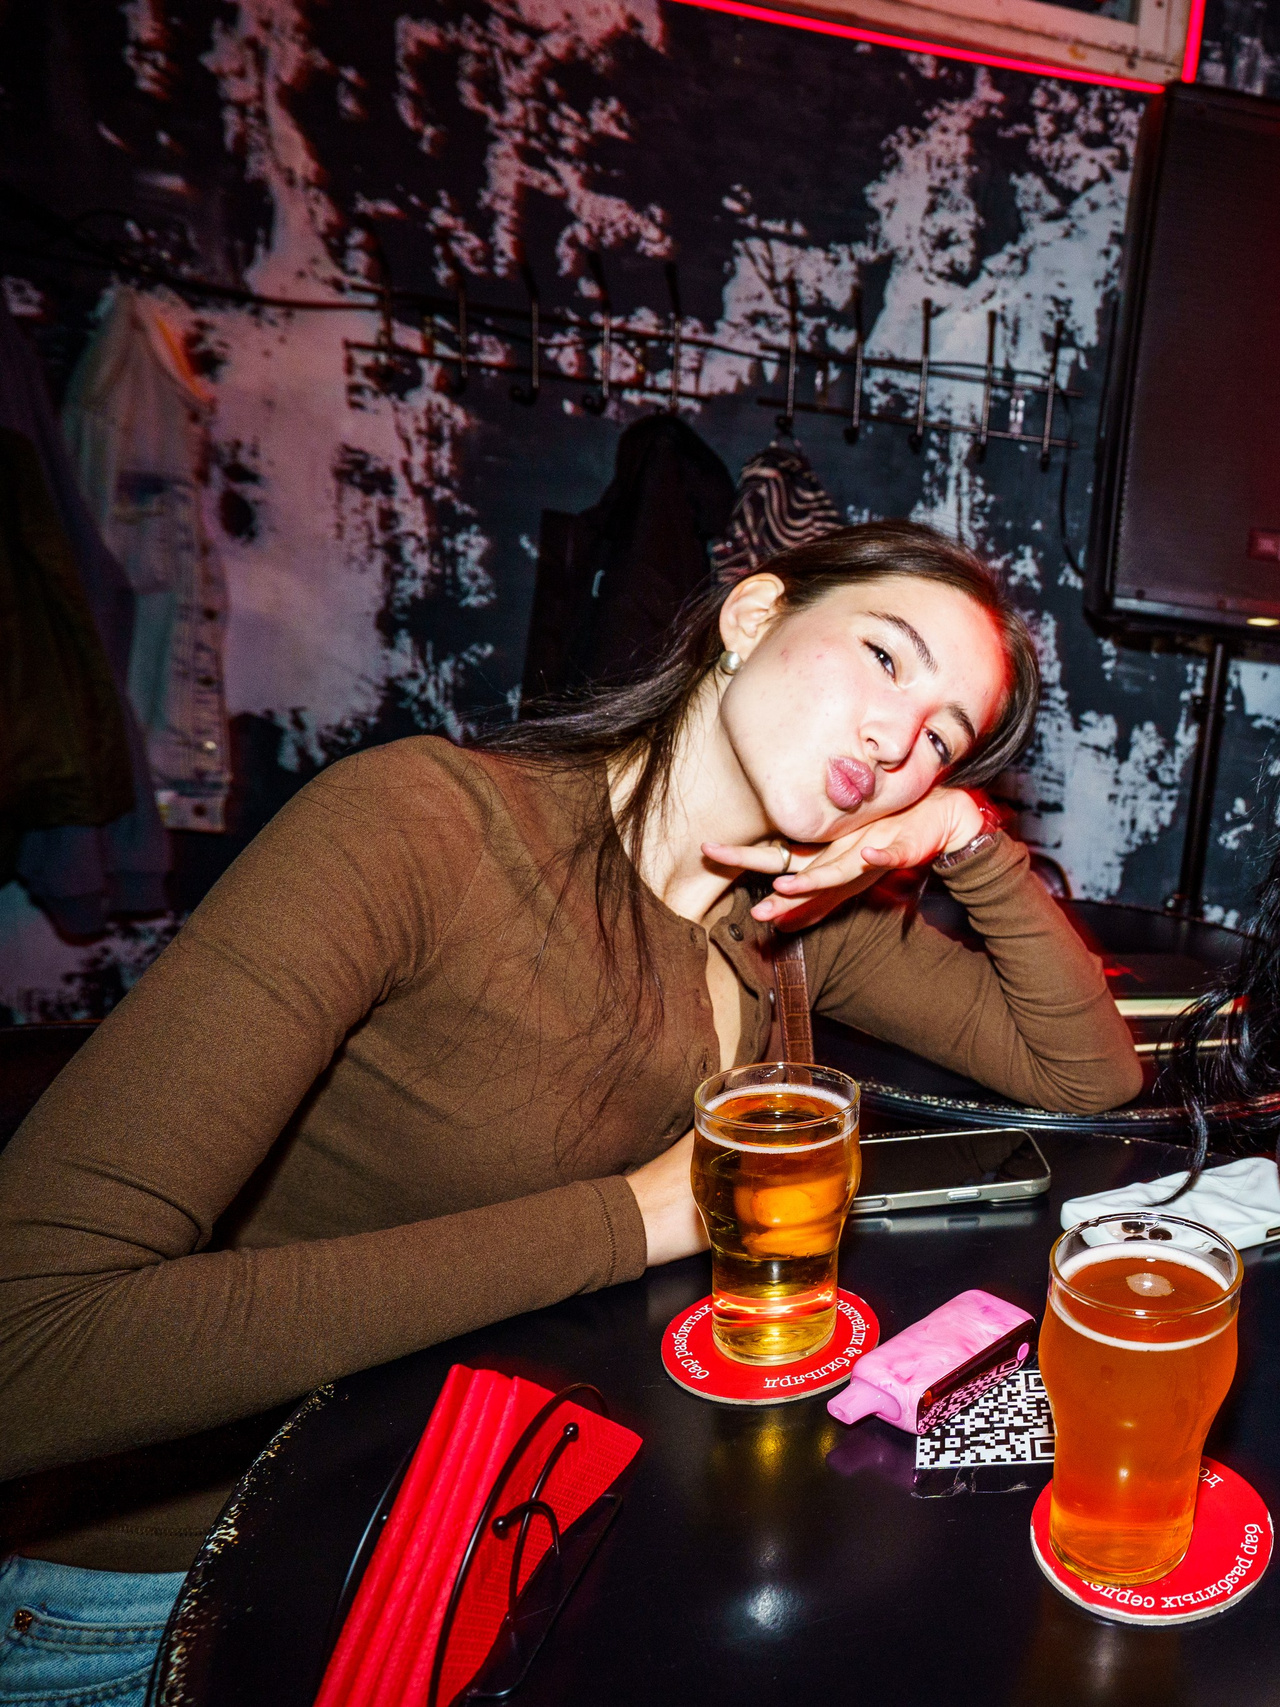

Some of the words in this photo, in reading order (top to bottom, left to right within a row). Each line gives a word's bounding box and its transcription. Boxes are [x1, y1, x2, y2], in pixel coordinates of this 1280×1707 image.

[671, 1303, 713, 1359] разбитых
[843, 1346, 863, 1358] &
[681, 1358, 710, 1380] бар
[763, 1355, 851, 1389] бильярд
[1240, 1523, 1264, 1556] бар
[1082, 1579, 1155, 1609] серде
[1160, 1555, 1254, 1609] разбитых
